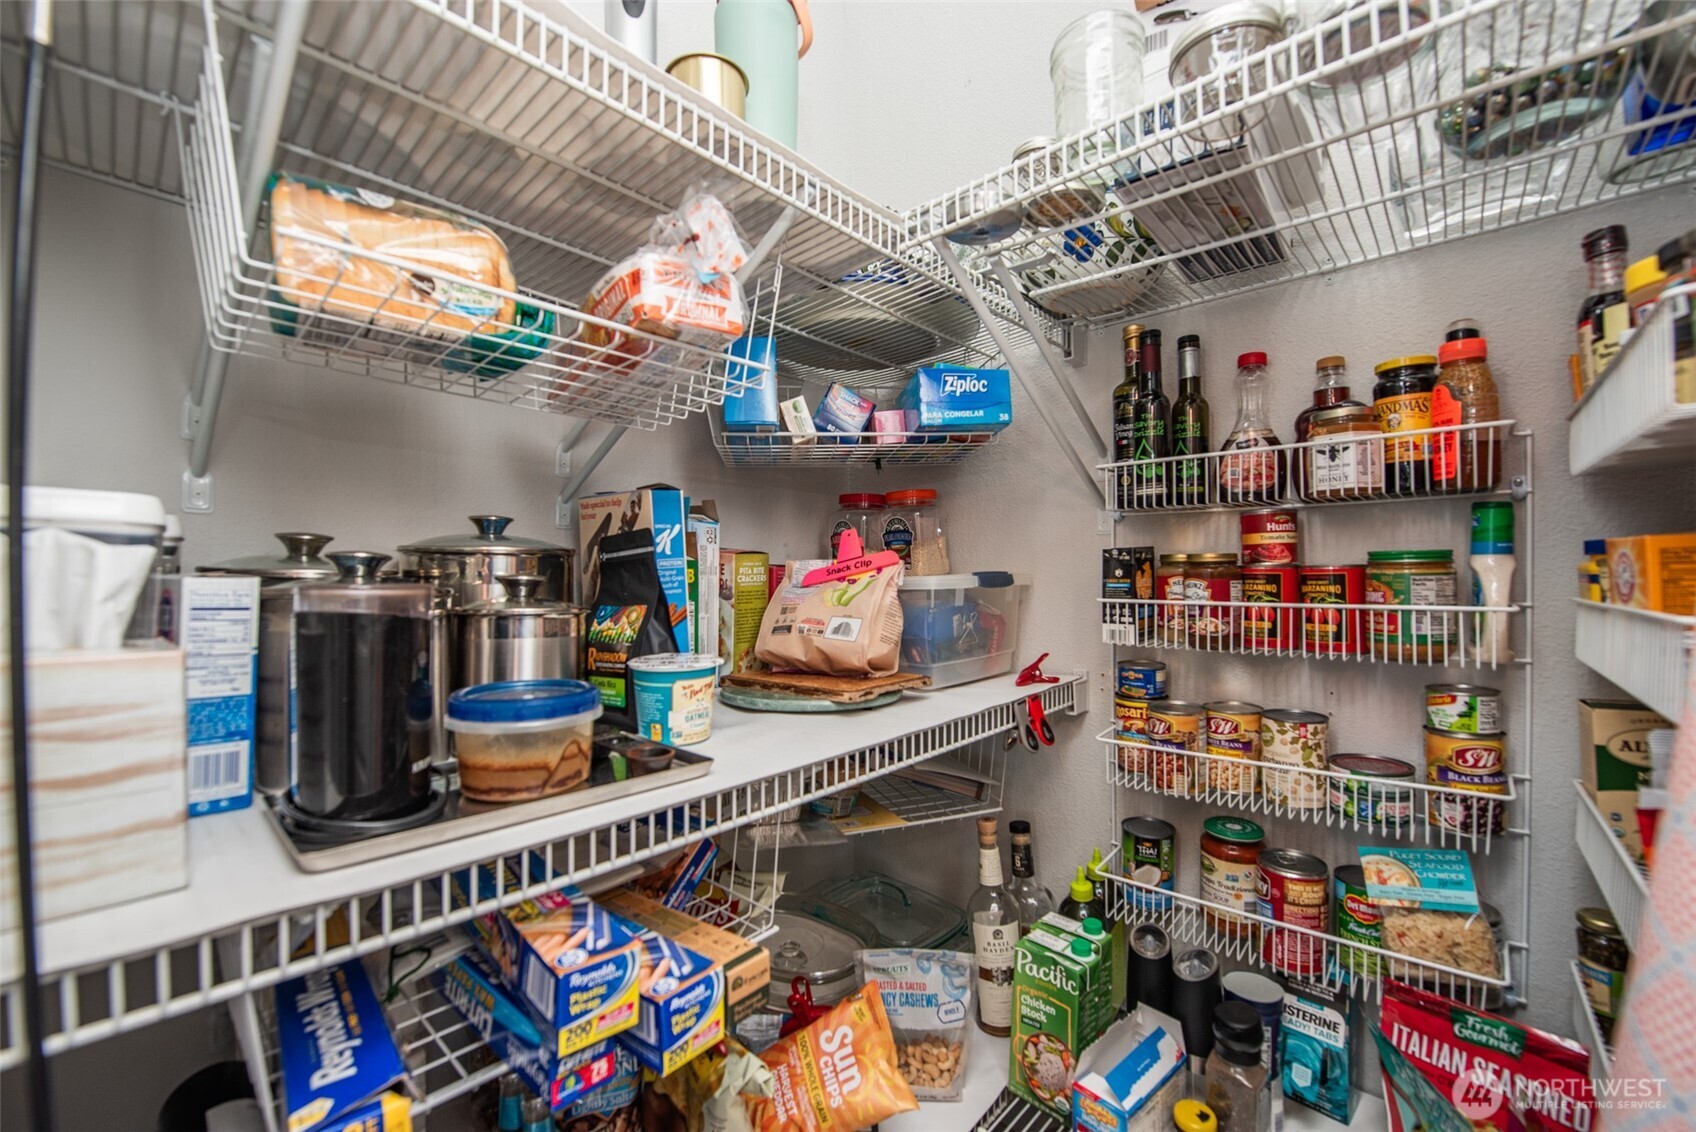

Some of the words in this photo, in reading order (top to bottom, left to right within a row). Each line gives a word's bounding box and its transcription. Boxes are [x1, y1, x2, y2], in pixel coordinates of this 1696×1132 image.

[944, 376, 988, 397] Ziploc
[944, 410, 984, 418] CONGELAR
[655, 523, 681, 555] K
[826, 564, 851, 576] Snack
[854, 559, 872, 570] Clip
[736, 575, 767, 583] CRACKERS
[1447, 770, 1482, 784] BLACK
[1136, 844, 1158, 856] THAI
[1389, 848, 1421, 859] PUGET
[1424, 849, 1462, 861] SOUND
[1407, 859, 1465, 871] SEAFOOD
[1415, 869, 1467, 881] CHOWDER
[1345, 898, 1359, 911] Del
[987, 940, 1009, 948] BASIL
[569, 962, 618, 988] Reynolds
[1014, 947, 1080, 996] Pacific
[569, 984, 608, 1005] Plastic
[878, 981, 898, 991] ASTED
[898, 981, 904, 991] &
[904, 981, 927, 992] SALTED
[569, 998, 602, 1017] Wrap
[880, 991, 897, 1008] NCY
[899, 992, 939, 1009] CASHEWS
[1021, 994, 1056, 1016] Chicken
[943, 1006, 961, 1017] WHOLE
[1021, 1005, 1048, 1023] Stock
[1282, 1003, 1341, 1035] ISTERINE
[565, 1020, 593, 1039] 200
[1313, 1027, 1341, 1044] TABS
[1465, 1013, 1510, 1041] Fresh
[303, 999, 363, 1092] Reynolds
[1453, 1022, 1523, 1057] Gourmet
[819, 1024, 862, 1096] Sun
[799, 1034, 809, 1060] 100%
[804, 1060, 818, 1093] WHOLE
[812, 1092, 829, 1124] GRAIN
[820, 1055, 843, 1109] CHIPS
[1390, 1022, 1467, 1079] ITALIAN
[1470, 1056, 1592, 1132] SEASONED
[777, 1063, 798, 1116] HARVEST
